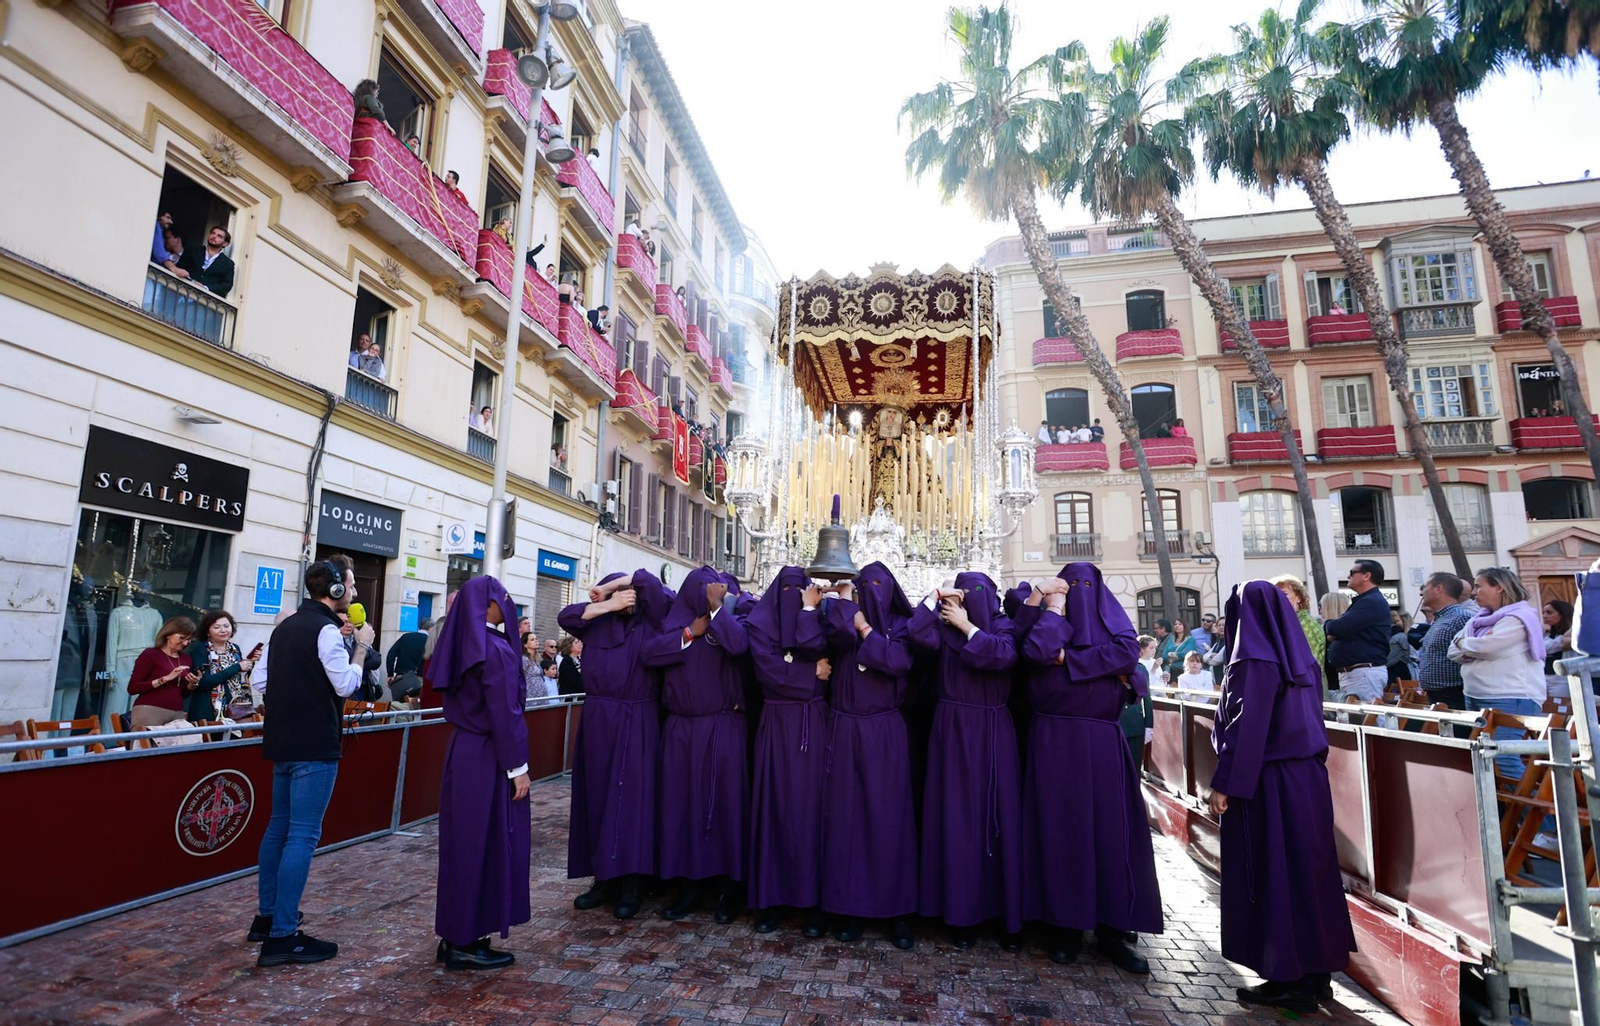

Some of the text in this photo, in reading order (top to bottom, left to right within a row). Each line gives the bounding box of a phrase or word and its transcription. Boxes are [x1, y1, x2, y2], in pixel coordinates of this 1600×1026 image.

[95, 472, 242, 516] SCALPERS
[322, 504, 392, 531] LODGING
[342, 523, 373, 536] MALAGA
[362, 542, 394, 553] APARTAMENTOS
[544, 558, 570, 571] EL GANSO
[259, 570, 282, 590] AT
